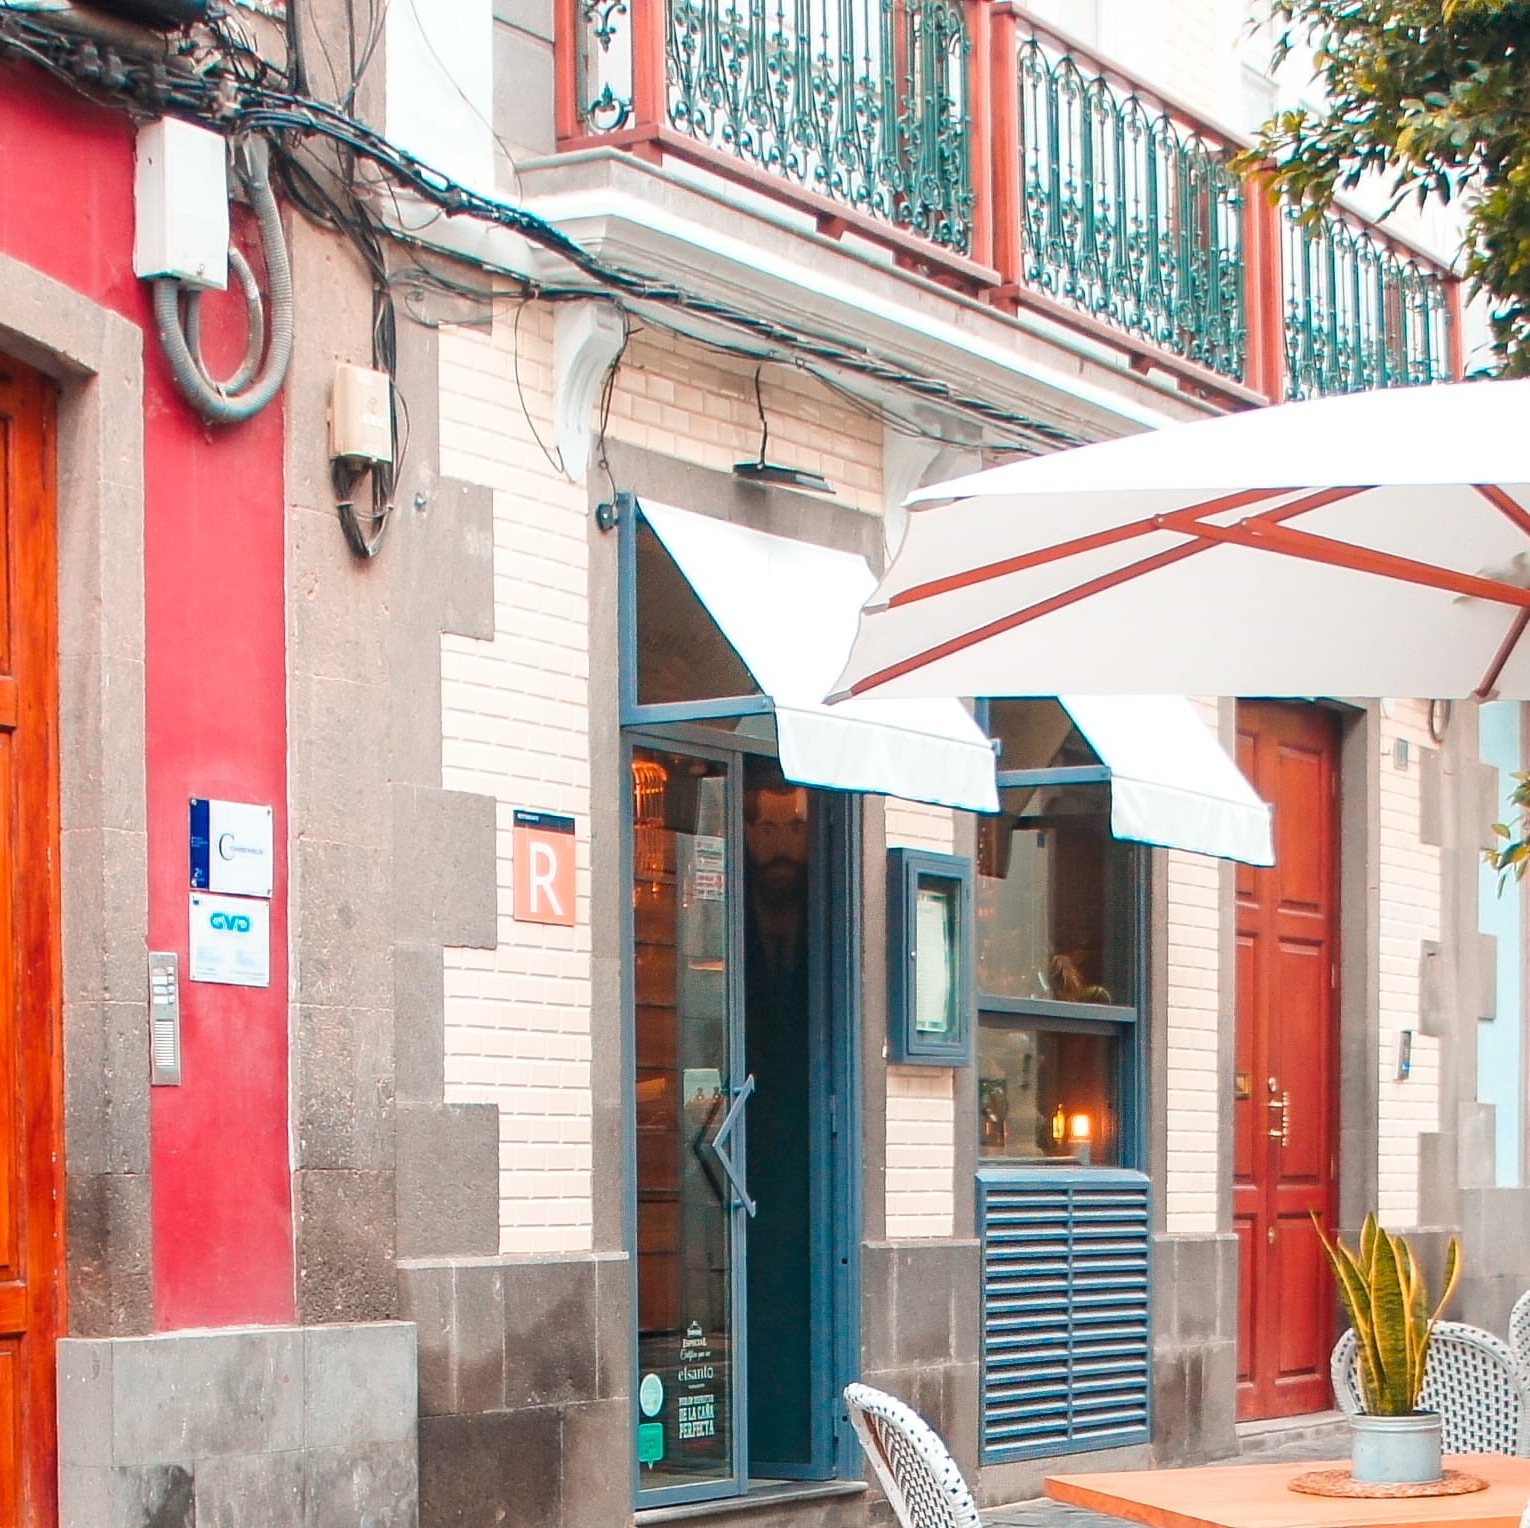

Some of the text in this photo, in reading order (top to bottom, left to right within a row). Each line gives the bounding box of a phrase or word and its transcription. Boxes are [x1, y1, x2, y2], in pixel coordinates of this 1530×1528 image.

[529, 841, 564, 916] R
[688, 1406, 697, 1421] LA
[679, 1420, 715, 1439] PERFECTA
